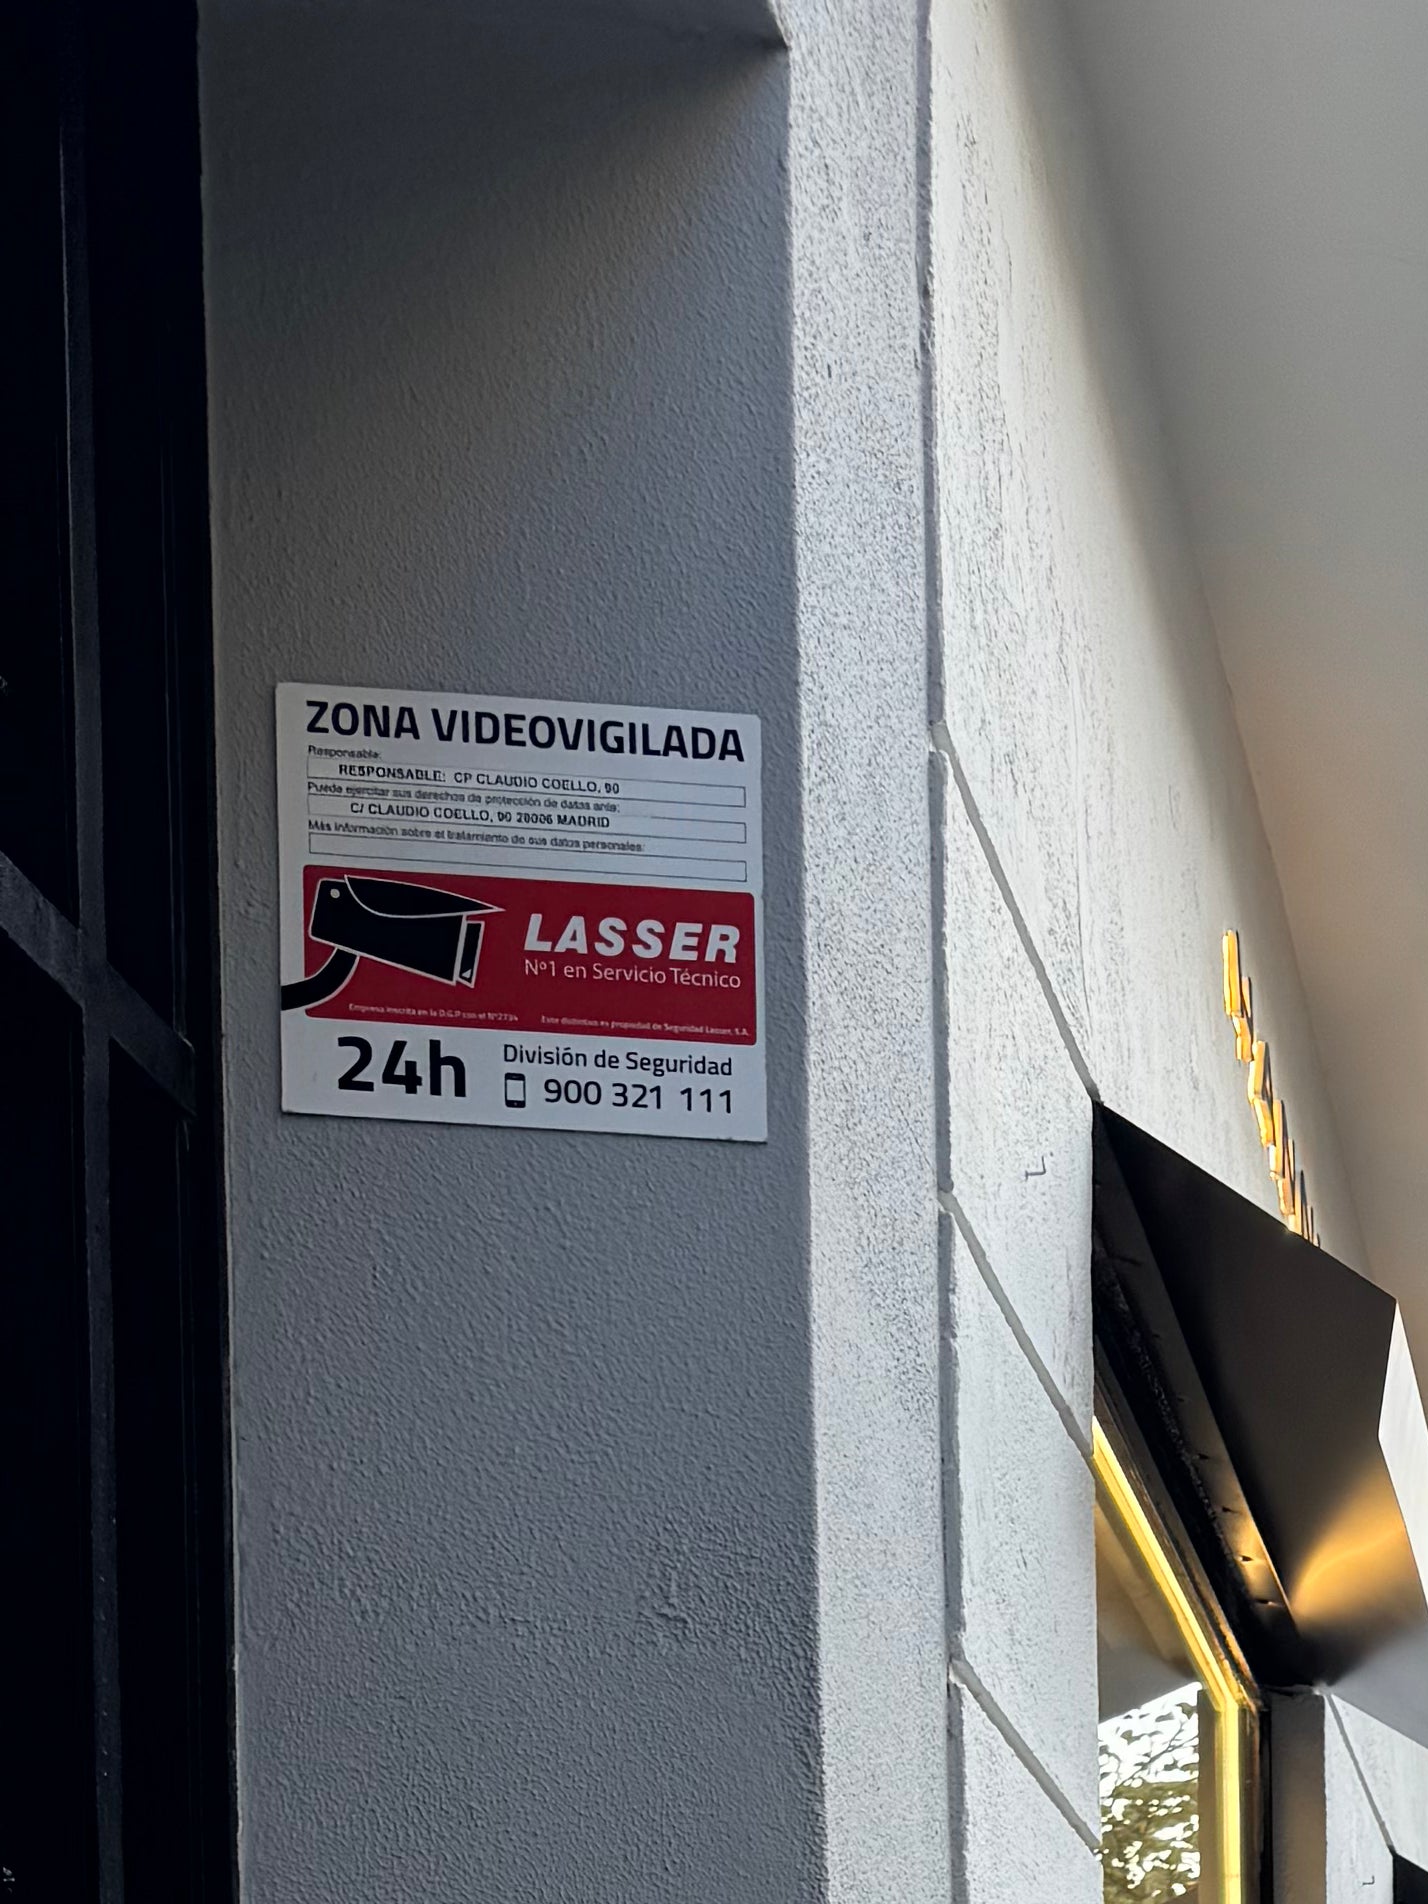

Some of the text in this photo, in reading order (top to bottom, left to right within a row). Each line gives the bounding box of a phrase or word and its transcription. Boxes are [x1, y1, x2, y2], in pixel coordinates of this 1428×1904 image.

[306, 700, 745, 762] ZONA VIDEOVIGILADA
[339, 763, 446, 782] RESPONSABLE:
[454, 771, 472, 784] CP
[476, 773, 538, 789] CLAUDIO
[368, 804, 429, 818] CLAUDIO
[557, 814, 610, 828] MADRID
[524, 913, 741, 963] LASSER
[563, 965, 587, 980] en
[593, 962, 667, 984] Servicio
[669, 966, 741, 989] Técnico
[337, 1036, 467, 1098] 24h
[503, 1044, 733, 1077] División de Seguridad
[544, 1078, 732, 1114] 900 321 111
